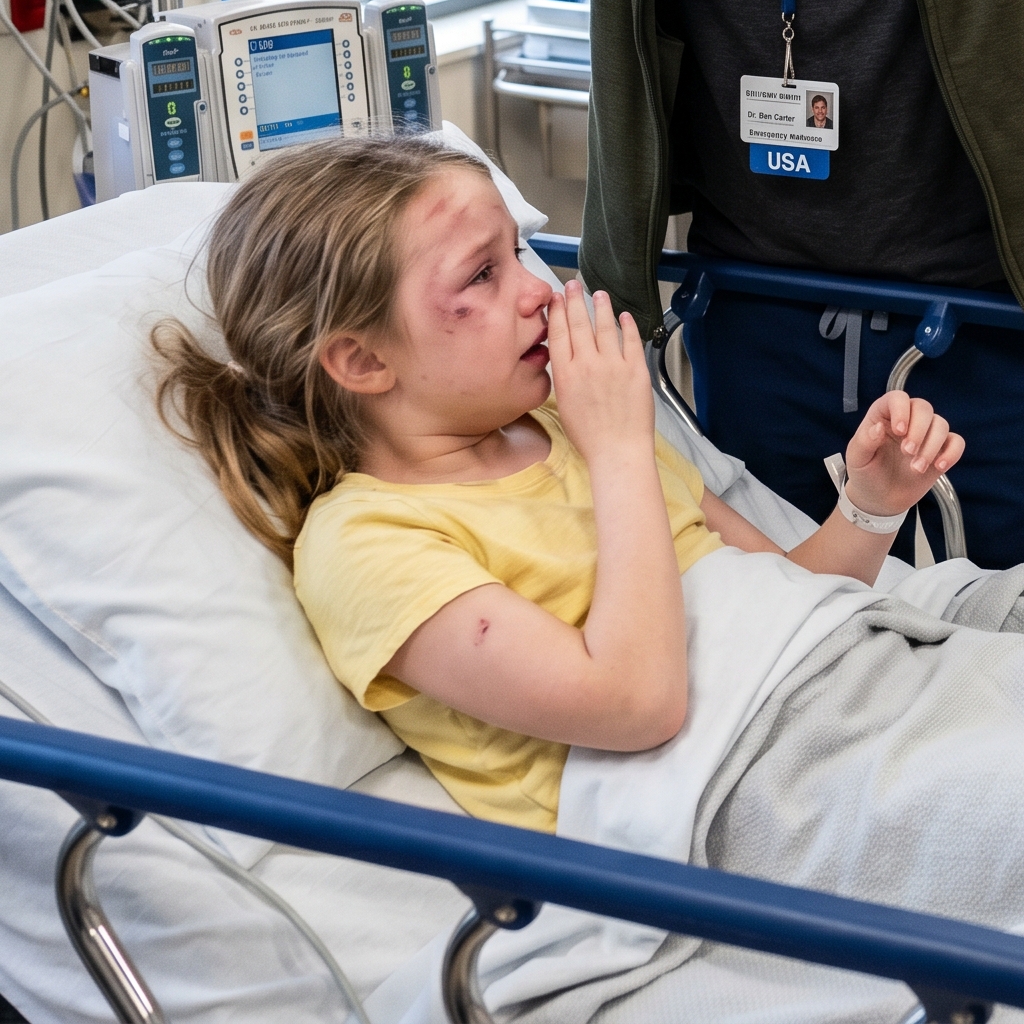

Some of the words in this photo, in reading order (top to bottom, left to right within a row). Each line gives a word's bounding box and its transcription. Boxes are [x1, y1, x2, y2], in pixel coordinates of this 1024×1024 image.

[748, 111, 757, 119] Dr.
[759, 112, 772, 120] Ben
[774, 113, 795, 123] Carter
[767, 151, 811, 173] USA
